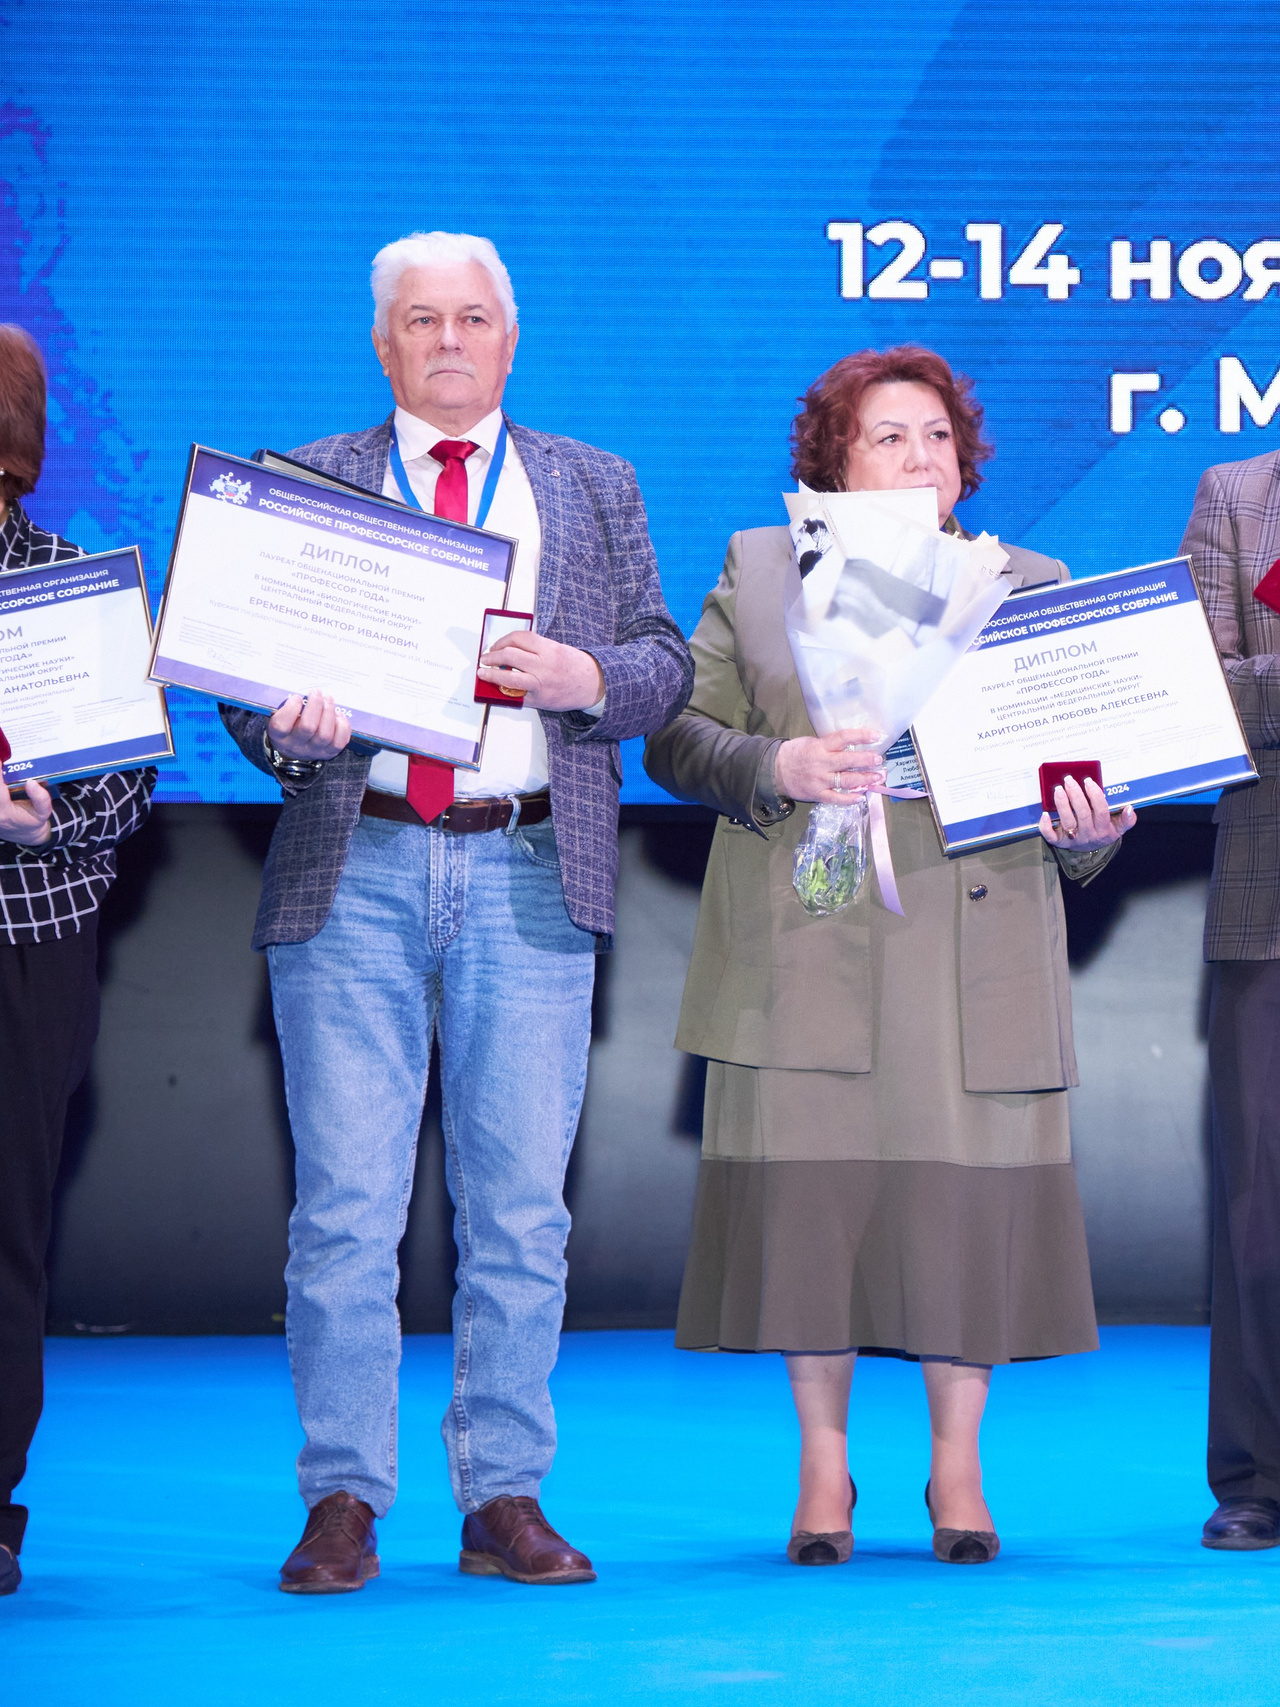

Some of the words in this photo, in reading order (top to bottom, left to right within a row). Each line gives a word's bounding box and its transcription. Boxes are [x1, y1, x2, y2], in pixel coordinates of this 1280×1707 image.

[826, 221, 1081, 299] 12-14
[1111, 373, 1186, 433] г.
[259, 498, 332, 525] РОССИЙСКОЕ
[334, 520, 429, 553] ПРОФЕССОРСКОЕ
[431, 547, 489, 571] СОБРАНИЕ
[268, 488, 351, 516] ОБЩЕРОССИЙСКАЯ
[352, 511, 421, 537] ОБЩЕСТВЕННАЯ
[422, 531, 483, 555] ОРГАНИЗАЦИЯ
[259, 551, 294, 565] ЛАУРЕАТ
[297, 562, 389, 591] ОБЩЕНАЦИОНАЛЬНОЙ
[391, 588, 425, 602] ПРЕМИИ
[300, 542, 390, 579] ДИПЛОМ
[0, 582, 41, 597] ТВЕННАЯ
[42, 569, 109, 588] ОРГАНИЗАЦИЯ
[57, 579, 119, 598] СОБРАНИЕ
[291, 570, 356, 595] «ПРОФЕССОР
[359, 589, 390, 604] ГОДА»
[1040, 594, 1106, 616] ОБЩЕСТВЕННАЯ
[1107, 580, 1167, 601] ОРГАНИЗАЦИЯ
[249, 596, 308, 620] ЕРЕМЕНКО
[311, 614, 354, 632] ВИКТОР
[357, 627, 418, 650] ИВАНОВИЧ
[260, 584, 321, 606] ЦЕНТРАЛЬНЫЙ
[323, 602, 385, 624] ФЕДЕРАЛЬНЫЙ
[387, 619, 412, 631] ОКРУГ
[1030, 604, 1121, 633] ПРОФЕССОРСКОЕ
[1122, 591, 1179, 611] СОБРАНИЕ
[31, 635, 66, 647] ПРЕМИИ
[1012, 639, 1098, 672] ДИПЛОМ
[3, 670, 89, 695] АНАТОЛЬЕВНА
[37, 664, 63, 674] ОКРУГ
[981, 680, 1015, 693] ЛАУРЕАТ
[1017, 657, 1105, 685] ОБЩЕНАЦИОНАЛЬНОЙ
[1106, 651, 1139, 663] ПРЕМИИ
[1016, 675, 1078, 696] «ПРОФЕССОР
[1081, 667, 1110, 681] ГОДА»
[977, 716, 1049, 741] ХАРИТОНОВА
[1051, 705, 1098, 723] ЛЮБОВЬ
[1100, 688, 1168, 712] АЛЕКСЕЕВНА
[996, 701, 1055, 722] ЦЕНТРАЛЬНЫЙ
[1057, 687, 1116, 707] ФЕДЕРАЛЬНЫЙ
[1117, 682, 1141, 692] ОКРУГ
[7, 761, 34, 774] 2024
[1106, 783, 1130, 797] 2024
